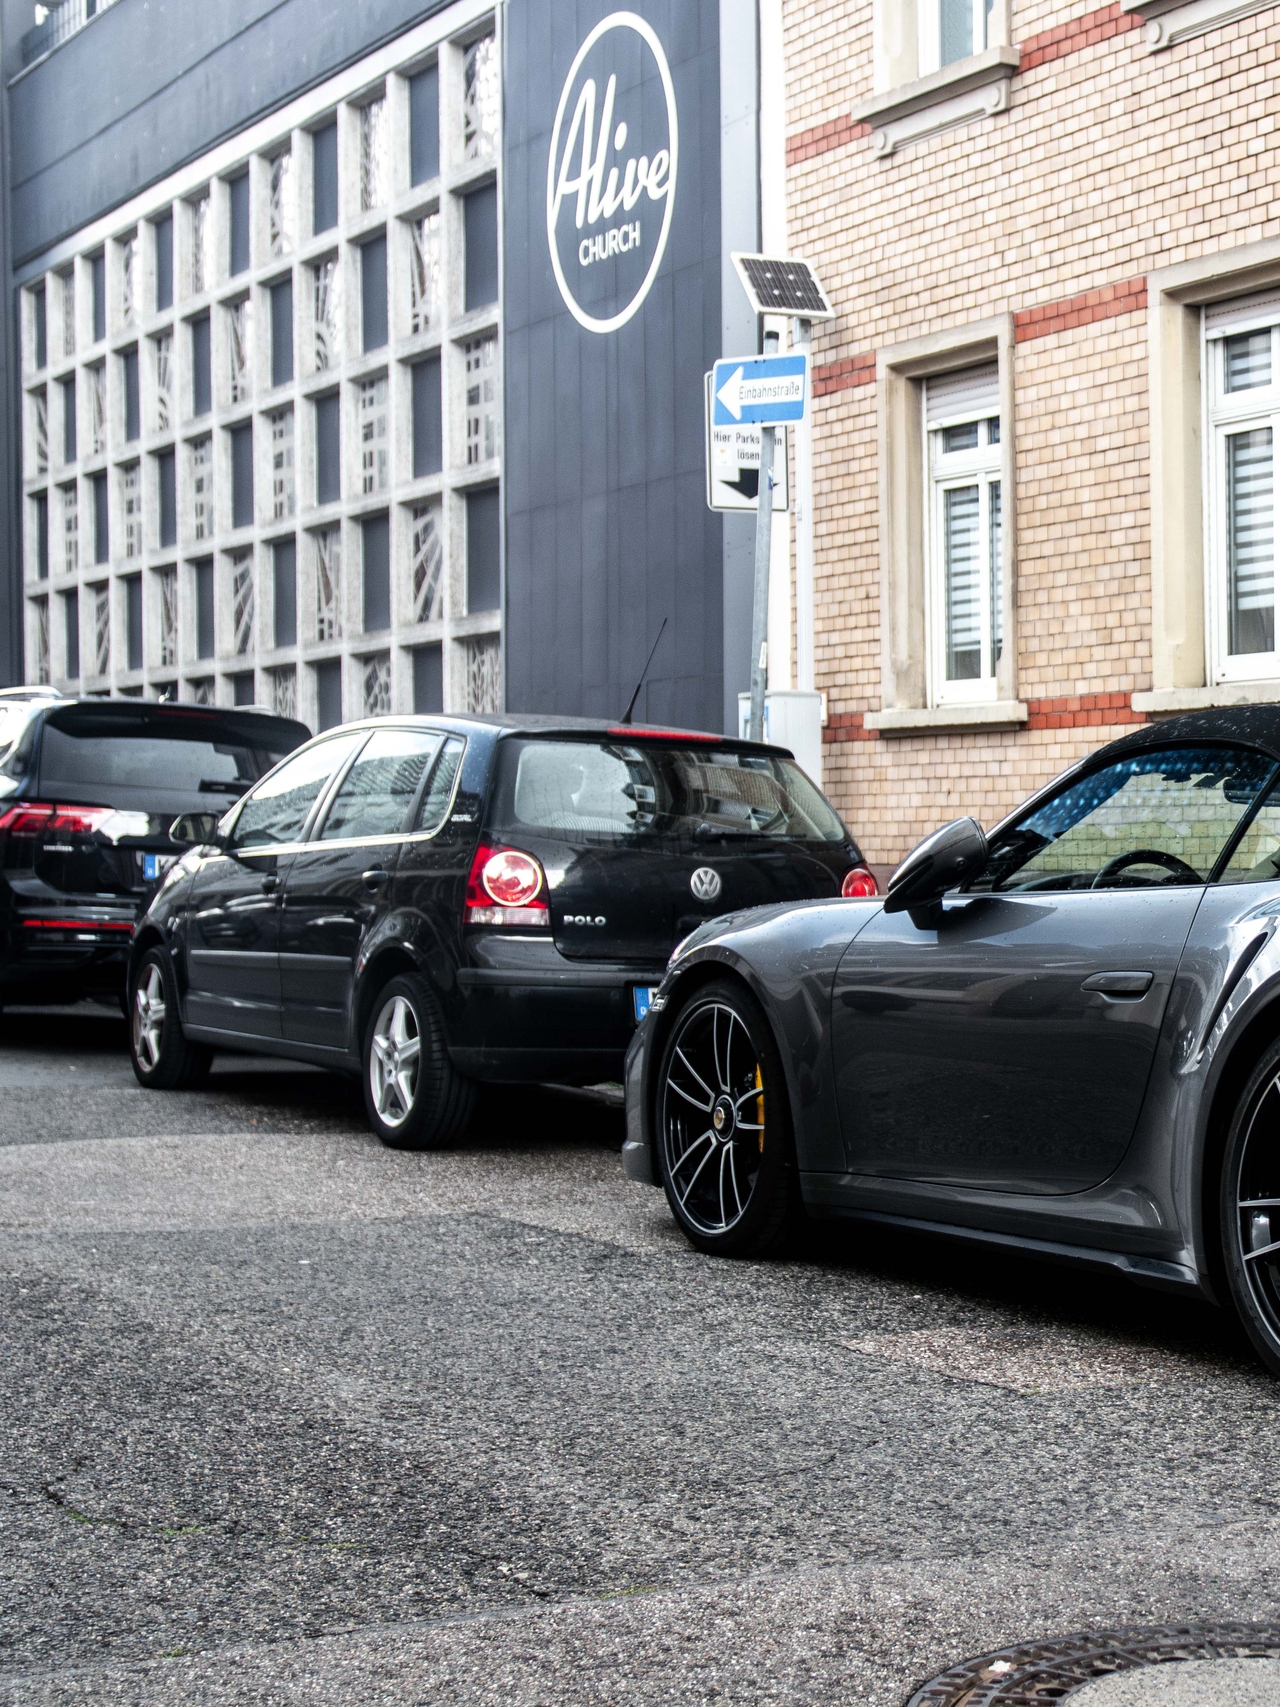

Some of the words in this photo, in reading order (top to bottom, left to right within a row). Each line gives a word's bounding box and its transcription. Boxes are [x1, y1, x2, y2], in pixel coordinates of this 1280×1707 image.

[553, 73, 670, 229] Alive
[578, 220, 641, 267] CHURCH
[738, 381, 800, 400] Einbahnstraße
[713, 431, 731, 443] Hier
[736, 432, 782, 446] Parksin
[737, 448, 760, 460] lösen
[563, 914, 607, 926] POLO
